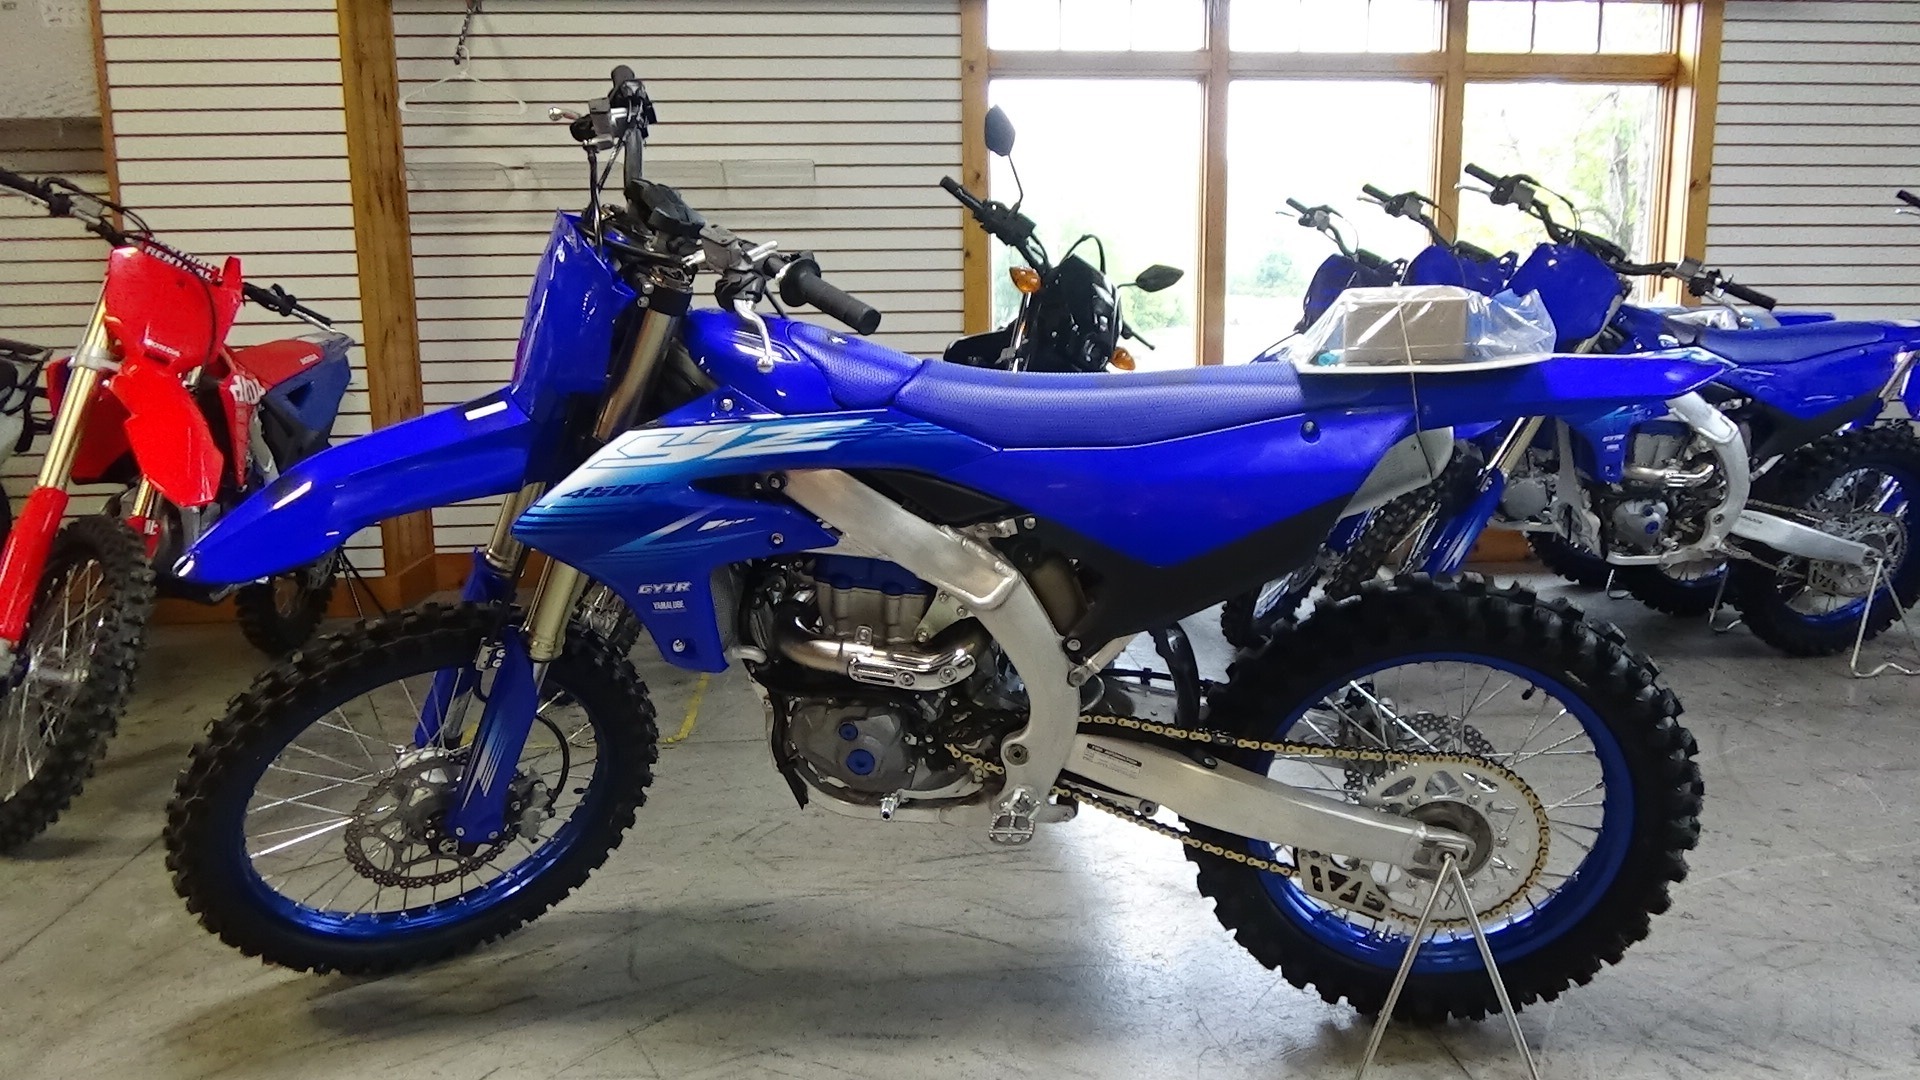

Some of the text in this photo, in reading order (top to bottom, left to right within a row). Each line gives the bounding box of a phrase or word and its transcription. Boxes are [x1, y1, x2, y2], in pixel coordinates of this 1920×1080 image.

[587, 418, 871, 469] YZ
[561, 482, 670, 498] 450F
[638, 581, 692, 595] GYTR
